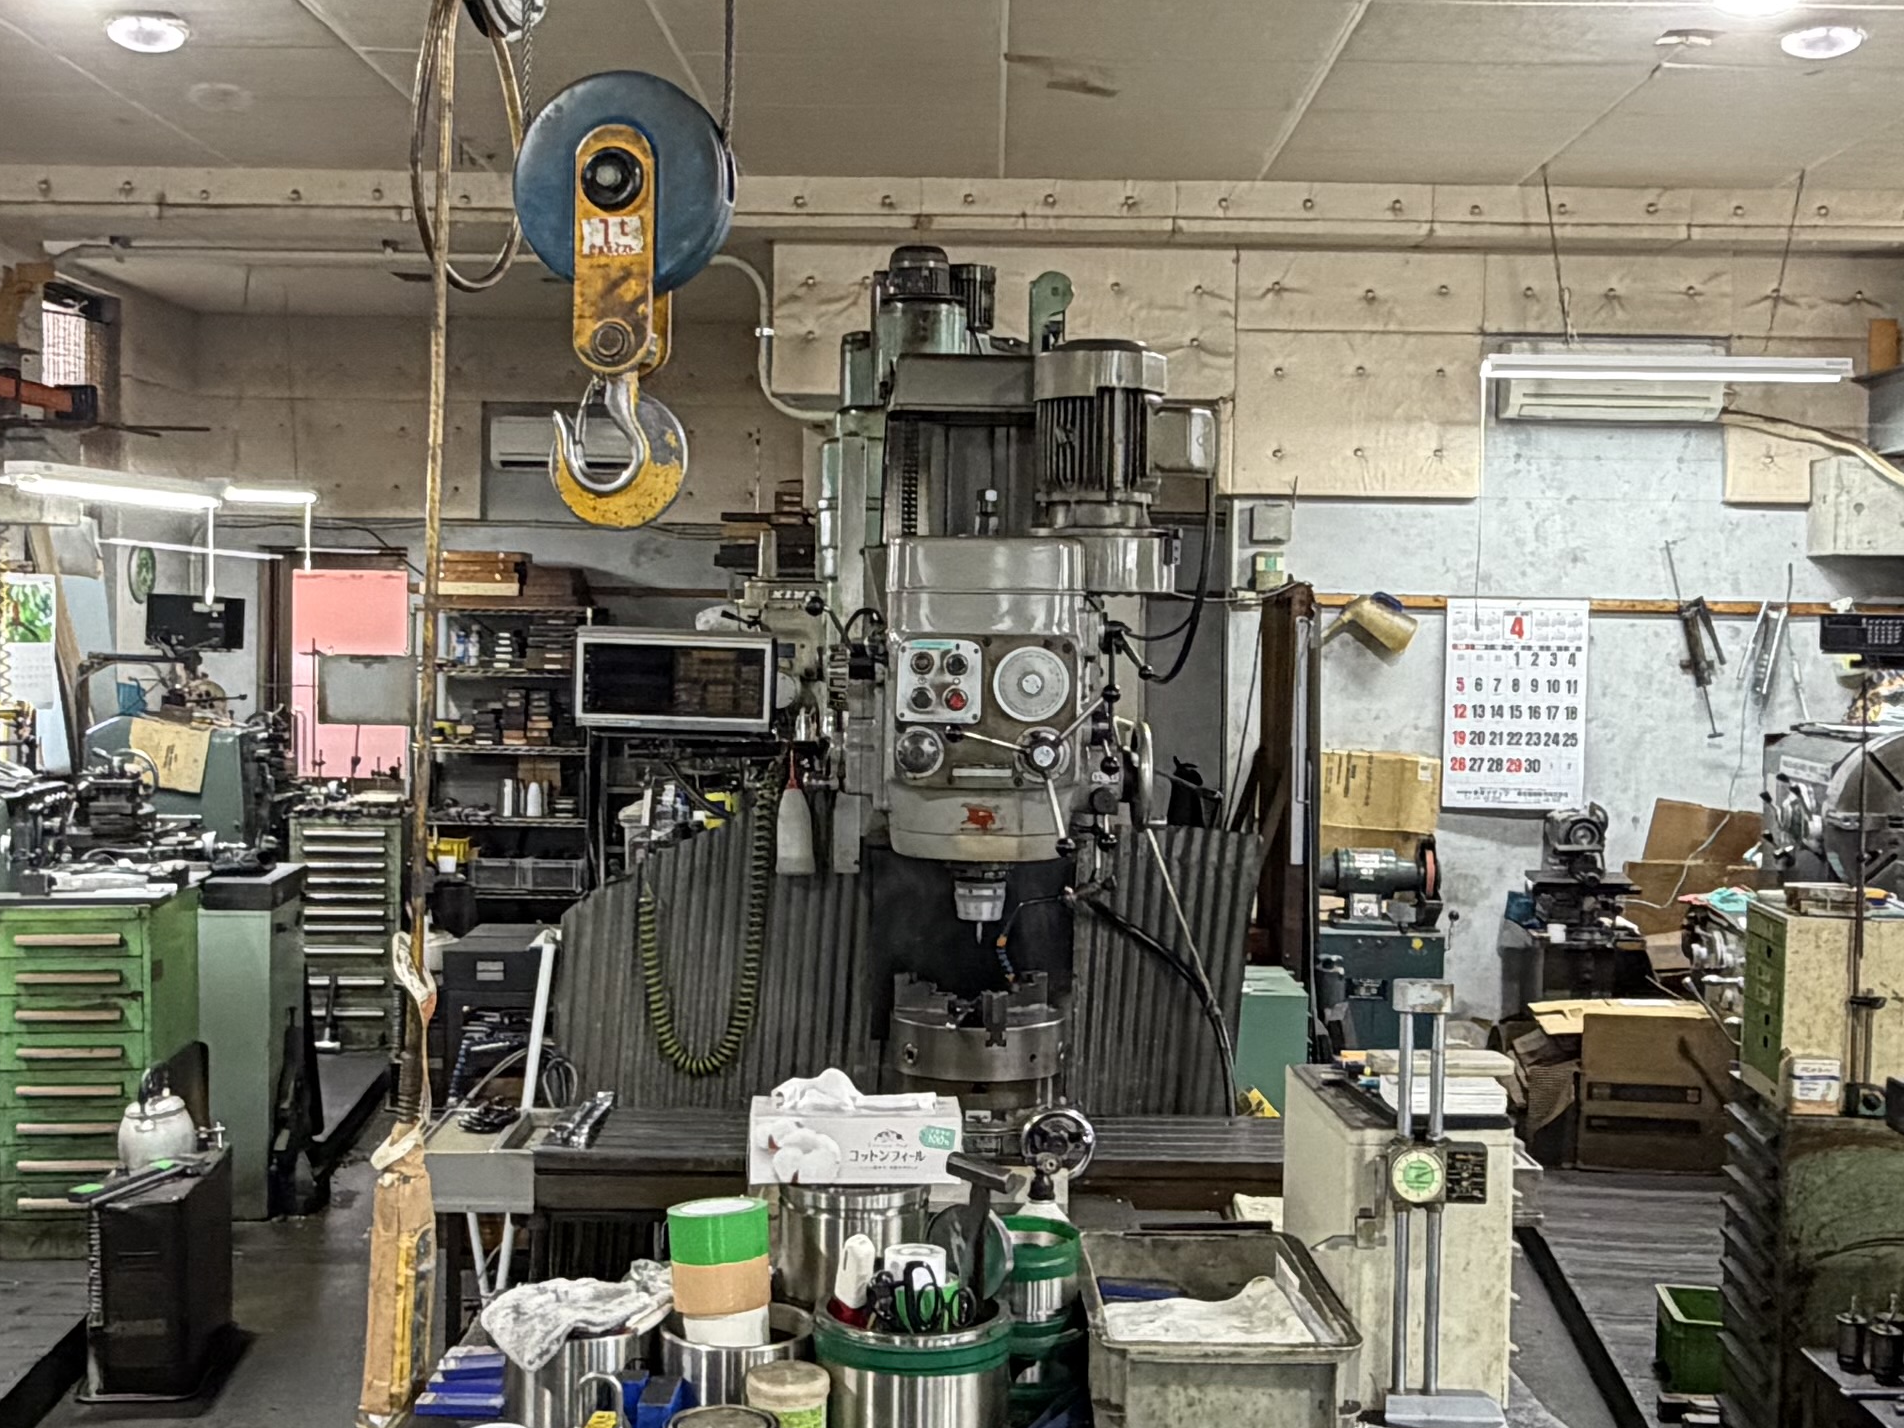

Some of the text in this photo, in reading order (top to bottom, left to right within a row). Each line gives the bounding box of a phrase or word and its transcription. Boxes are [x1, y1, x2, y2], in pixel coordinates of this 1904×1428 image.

[1510, 617, 1524, 639] 4
[1515, 652, 1520, 666] 1
[1531, 653, 1539, 667] 2
[1549, 653, 1558, 667] 3
[1568, 653, 1576, 667] 4
[1456, 677, 1577, 694] 5 6 7 8 9 10 11
[1453, 704, 1578, 720] 12 13 14 15 16 17 18
[1453, 731, 1578, 747] 19 20 21 22 23 24 25
[1450, 757, 1466, 771] 26
[1469, 758, 1484, 772] 27
[1487, 758, 1503, 772] 28
[1506, 759, 1522, 773] 29
[1524, 759, 1541, 773] 30
[849, 1150, 926, 1162] コットンフィール
